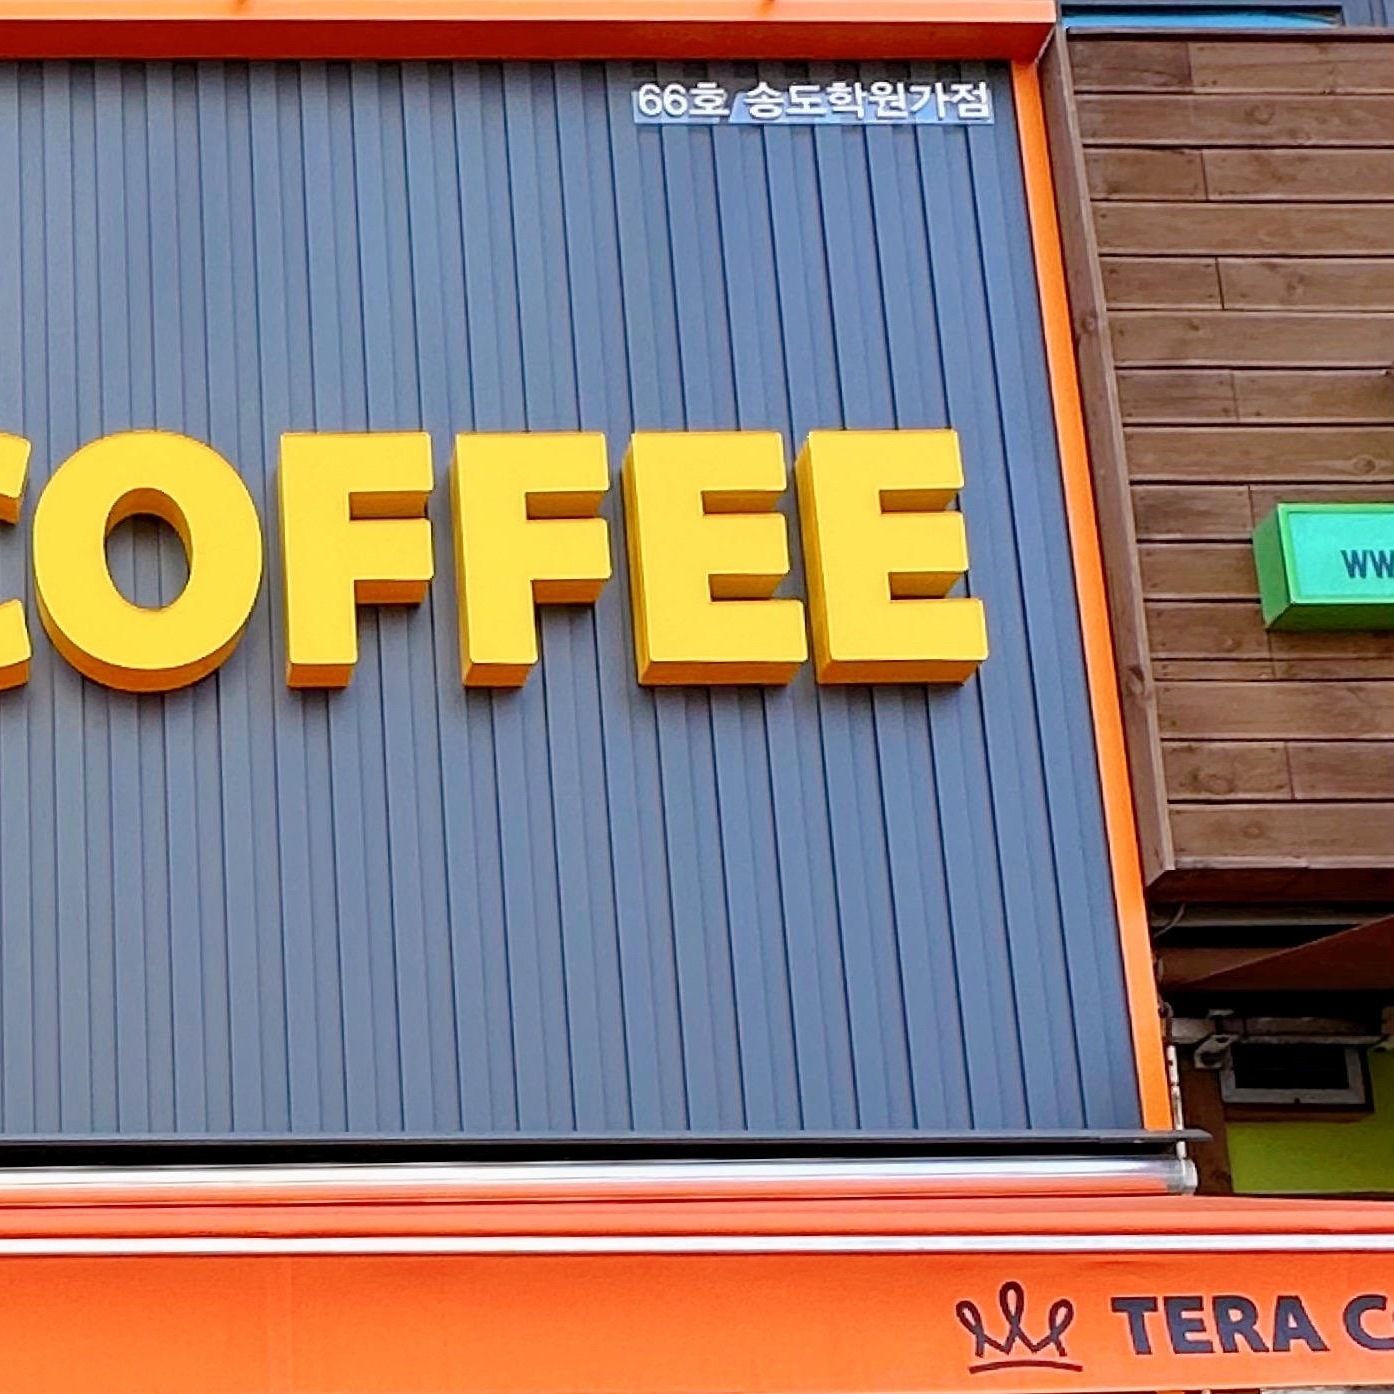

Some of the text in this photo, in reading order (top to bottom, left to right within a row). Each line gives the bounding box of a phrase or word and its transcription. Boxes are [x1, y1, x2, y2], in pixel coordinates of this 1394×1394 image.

[638, 80, 990, 120] 66호 송도학원가점
[1110, 1293, 1394, 1355] TERA C
